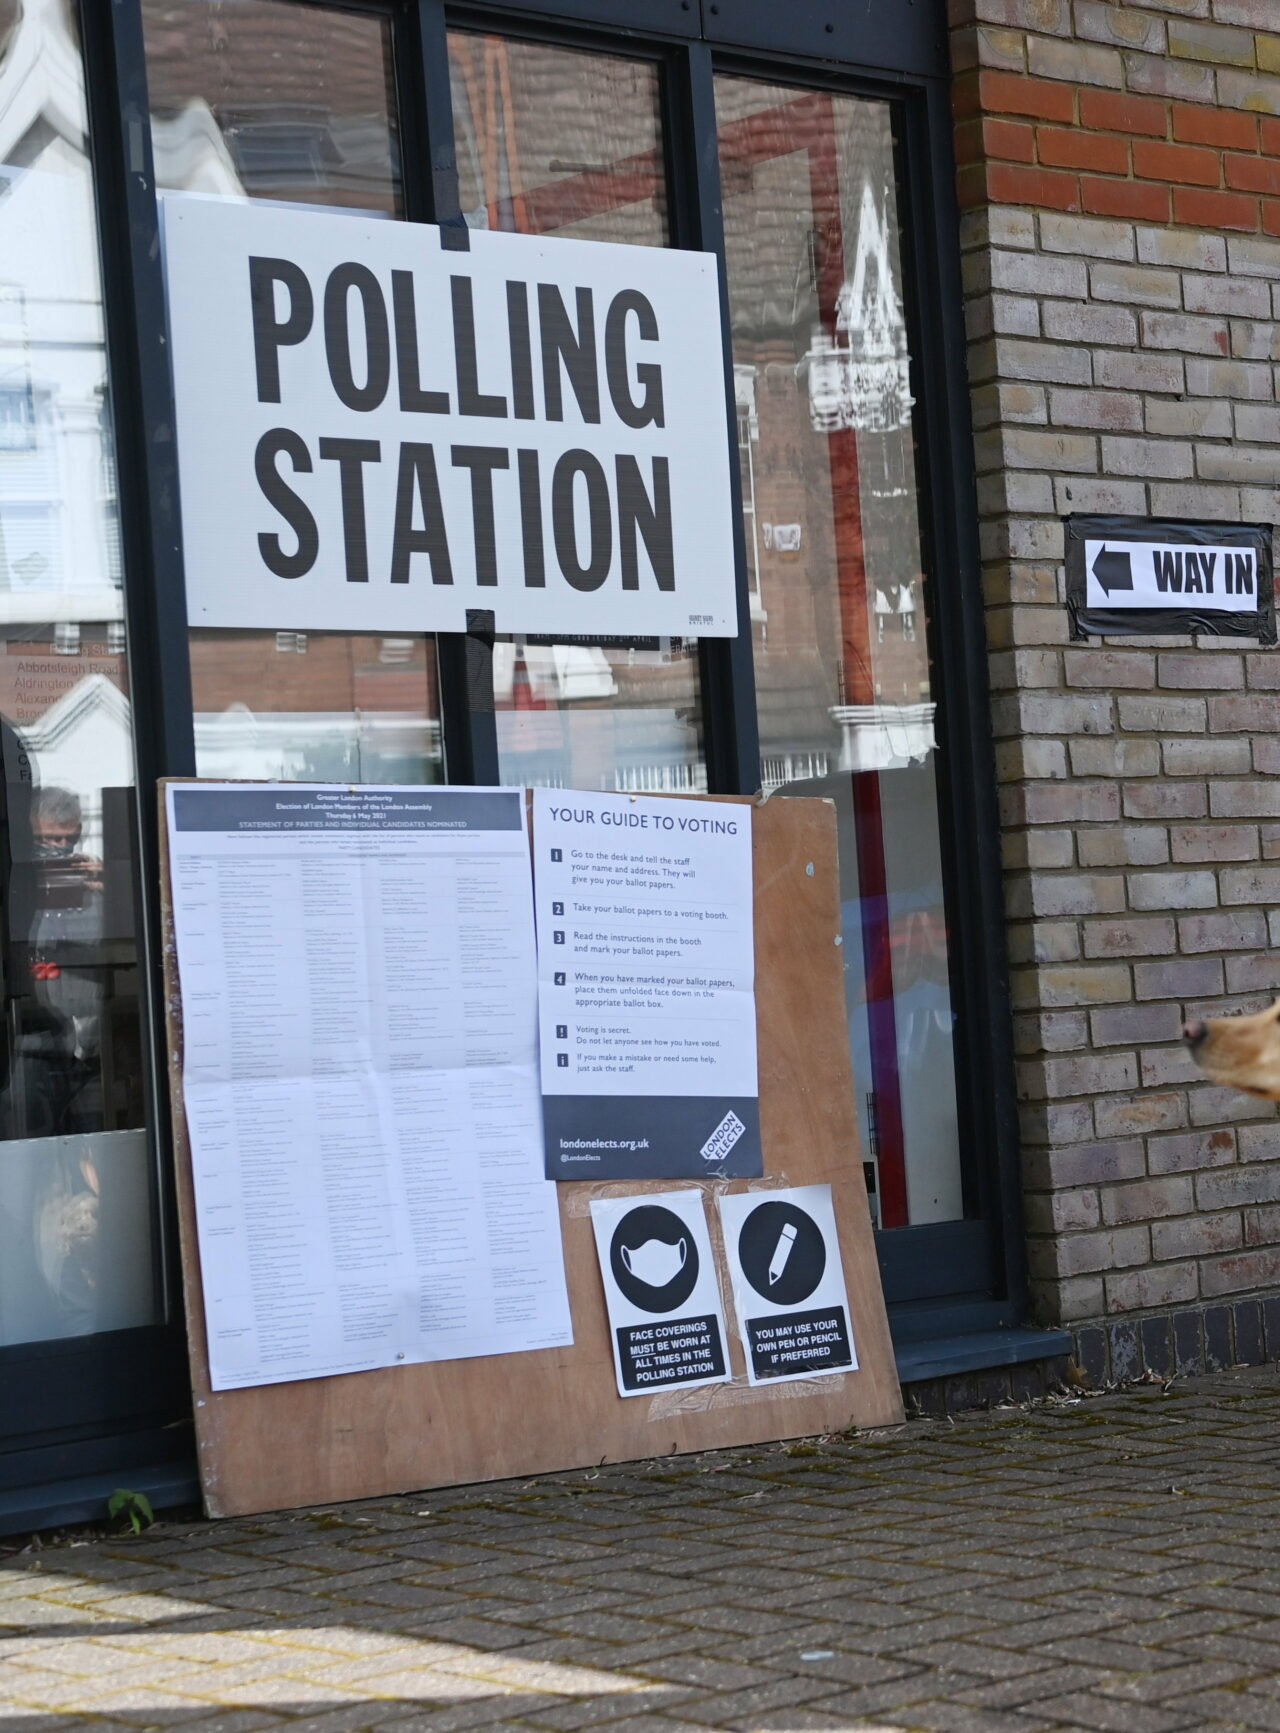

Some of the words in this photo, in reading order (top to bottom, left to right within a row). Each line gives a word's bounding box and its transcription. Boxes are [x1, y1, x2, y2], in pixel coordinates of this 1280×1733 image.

[249, 256, 665, 429] POLLING
[254, 427, 676, 593] STATION
[1153, 551, 1216, 594] WAY
[1225, 553, 1253, 594] IN
[550, 808, 595, 824] YOUR
[601, 811, 648, 829] GUIDE
[653, 816, 674, 830] TO
[678, 818, 737, 835] VOTING
[571, 850, 582, 859] Go
[597, 852, 608, 860] the
[611, 852, 627, 861] desk
[630, 854, 643, 862] and
[660, 856, 671, 864] the
[571, 864, 589, 872] your
[615, 865, 628, 873] and
[631, 867, 660, 875] address.
[663, 868, 680, 878] They
[683, 870, 695, 878] will
[572, 876, 587, 885] give
[590, 877, 604, 885] you
[607, 878, 623, 886] your
[626, 878, 646, 887] ballot
[649, 881, 675, 890] papers.
[573, 903, 591, 912] Take
[594, 905, 611, 914] your
[614, 905, 635, 914] ballot
[638, 908, 662, 917] papers
[681, 910, 703, 920] voting
[706, 911, 728, 919] booth.
[574, 932, 593, 940] Read
[596, 933, 608, 941] the
[611, 934, 654, 943] instructions
[657, 935, 663, 943] in
[666, 936, 677, 944] the
[680, 936, 701, 945] booth
[574, 945, 587, 953] and
[613, 948, 630, 956] your
[633, 947, 653, 956] ballot
[656, 948, 682, 958] papers.
[575, 973, 598, 982] When
[601, 976, 614, 984] you
[617, 975, 634, 983] have
[637, 975, 664, 984] marked
[667, 978, 684, 986] your
[686, 977, 706, 986] ballot
[709, 979, 735, 988] papers,
[575, 987, 595, 995] place
[598, 987, 617, 995] them
[620, 987, 652, 995] unfolded
[655, 988, 670, 996] face
[672, 989, 691, 997] down
[575, 999, 621, 1008] appropriate
[624, 999, 645, 1008] ballot
[647, 1000, 663, 1008] box.
[576, 1026, 598, 1034] Voting
[577, 1037, 587, 1045] Do
[603, 1037, 612, 1045] let
[615, 1039, 638, 1047] anyone
[655, 1038, 668, 1046] how
[685, 1039, 699, 1047] have
[577, 1053, 582, 1061] If
[599, 1054, 616, 1062] make
[625, 1054, 651, 1062] mistake
[663, 1055, 679, 1063] need
[700, 1055, 716, 1064] help,
[577, 1064, 589, 1073] just
[619, 1064, 635, 1073] staff.
[560, 1138, 649, 1150] londonelects.org.uk
[703, 1115, 736, 1157] LONDON
[715, 1123, 743, 1159] ELECTS
[630, 1330, 653, 1340] FACE
[655, 1322, 707, 1338] COVERINGS
[756, 1329, 774, 1340] YOU
[775, 1325, 792, 1337] MAY
[795, 1324, 812, 1334] USE
[813, 1319, 837, 1331] YOUR
[631, 1344, 655, 1355] MUST
[657, 1342, 669, 1352] BE
[671, 1338, 698, 1350] WORN
[701, 1335, 710, 1345] AT
[756, 1341, 777, 1353] OWN
[779, 1339, 795, 1350] PEN
[797, 1337, 809, 1347] OR
[811, 1331, 841, 1345] PENCIL
[635, 1358, 653, 1369] ALL
[654, 1352, 680, 1366] TIMES
[683, 1351, 692, 1362] IN
[694, 1349, 711, 1360] THE
[772, 1355, 779, 1364] IF
[781, 1347, 830, 1362] PREFERRED
[637, 1368, 675, 1382] POLLING
[677, 1362, 714, 1376] STATION
